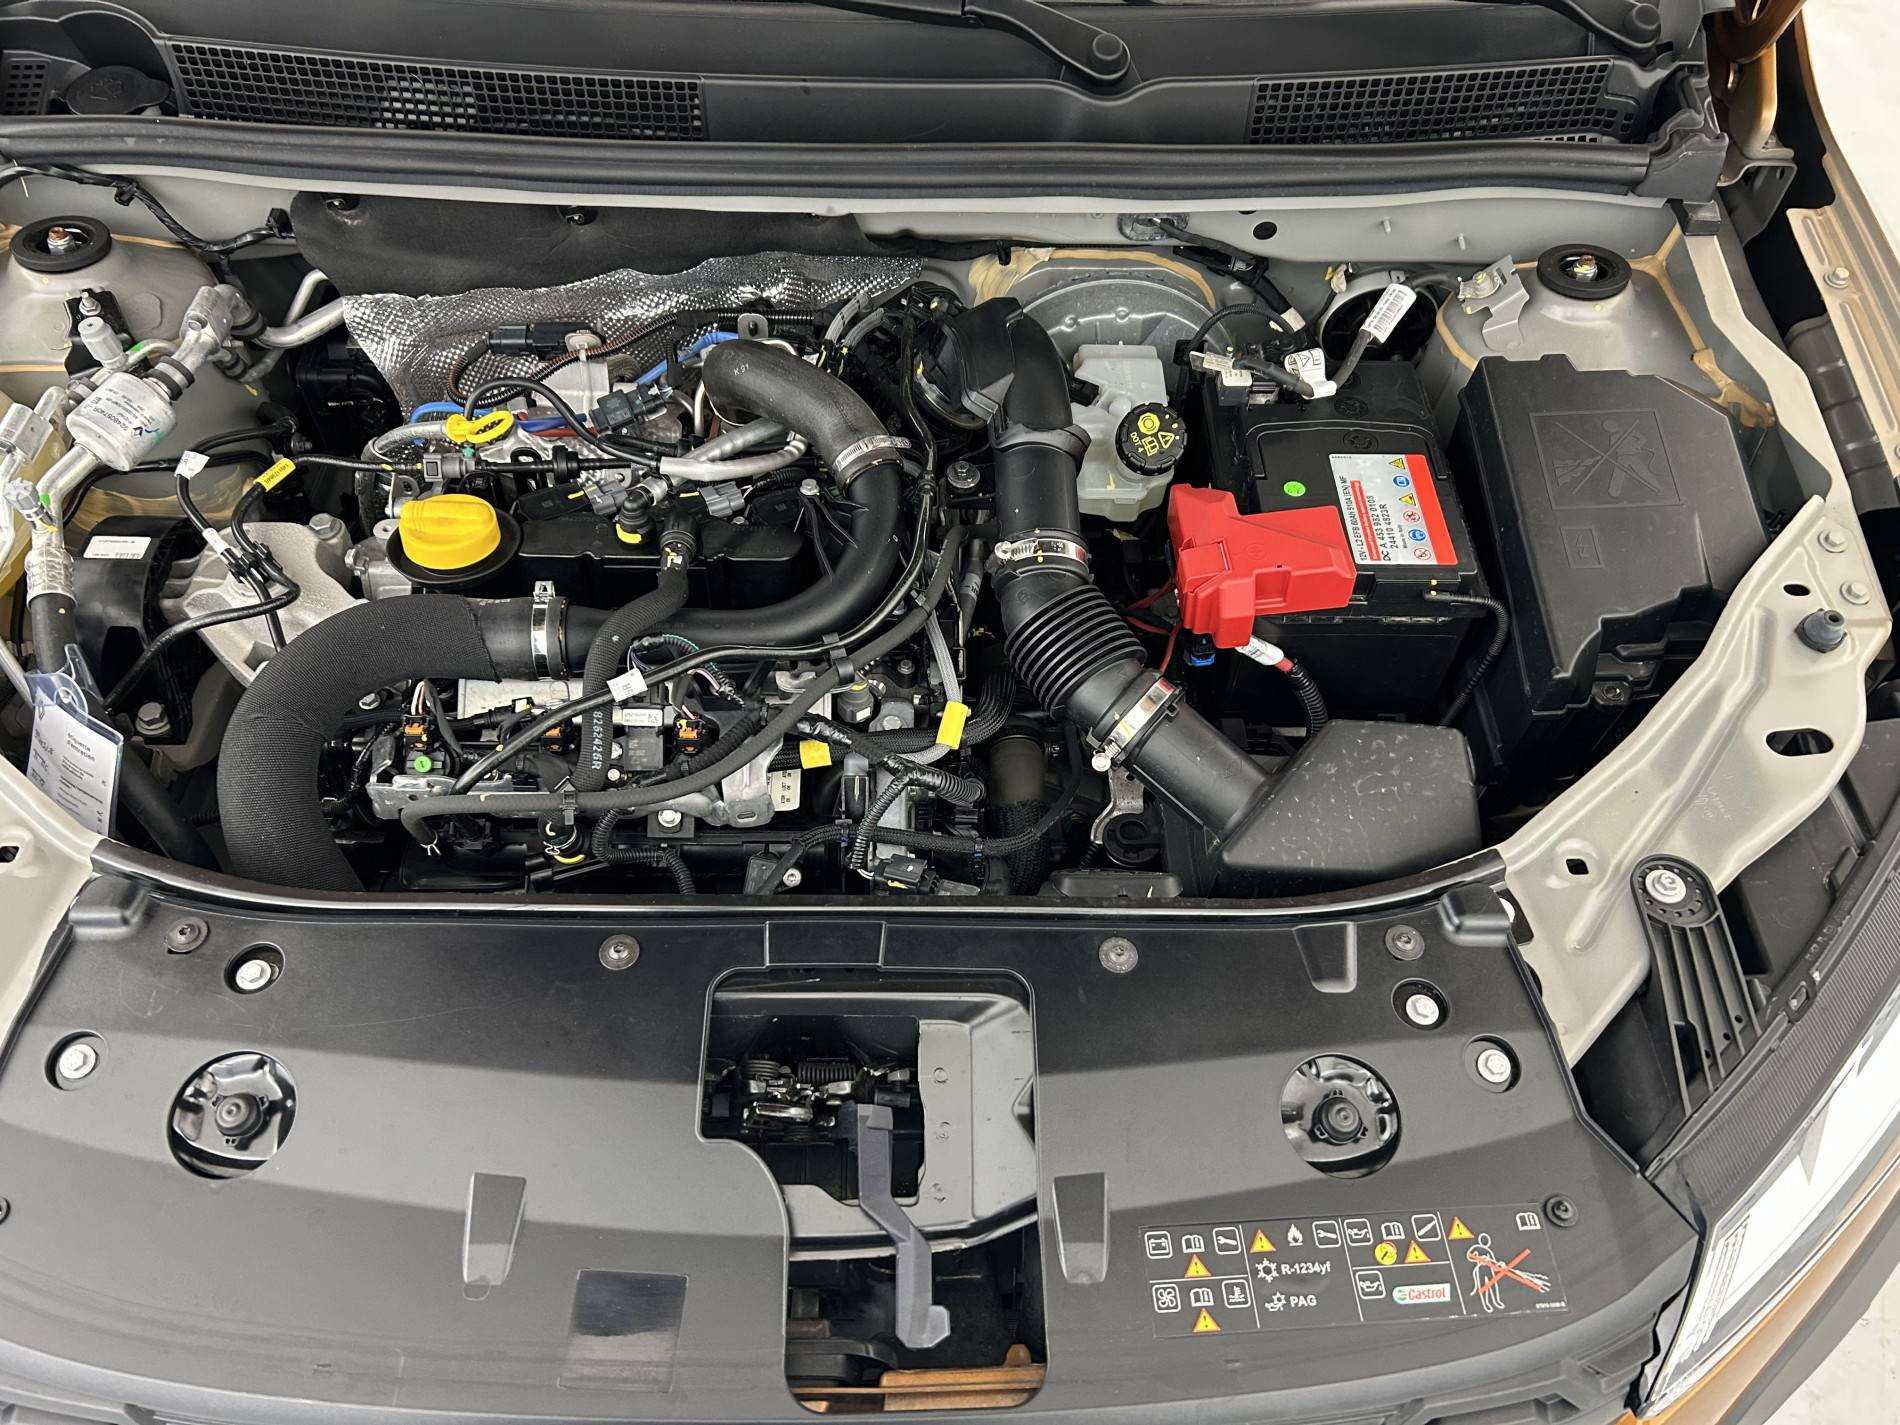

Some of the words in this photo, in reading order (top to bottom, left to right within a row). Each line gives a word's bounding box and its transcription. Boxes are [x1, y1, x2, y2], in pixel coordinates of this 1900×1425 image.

[1130, 431, 1142, 447] DOT
[1379, 503, 1391, 525] 4823R
[1352, 526, 1362, 539] EFB
[1376, 527, 1384, 541] 453
[1386, 527, 1399, 549] 24410
[1358, 550, 1368, 561] 12V
[1280, 1260, 1331, 1275] R-1234yf
[1289, 1294, 1318, 1308] PAG
[1408, 1287, 1446, 1301] Castrol
